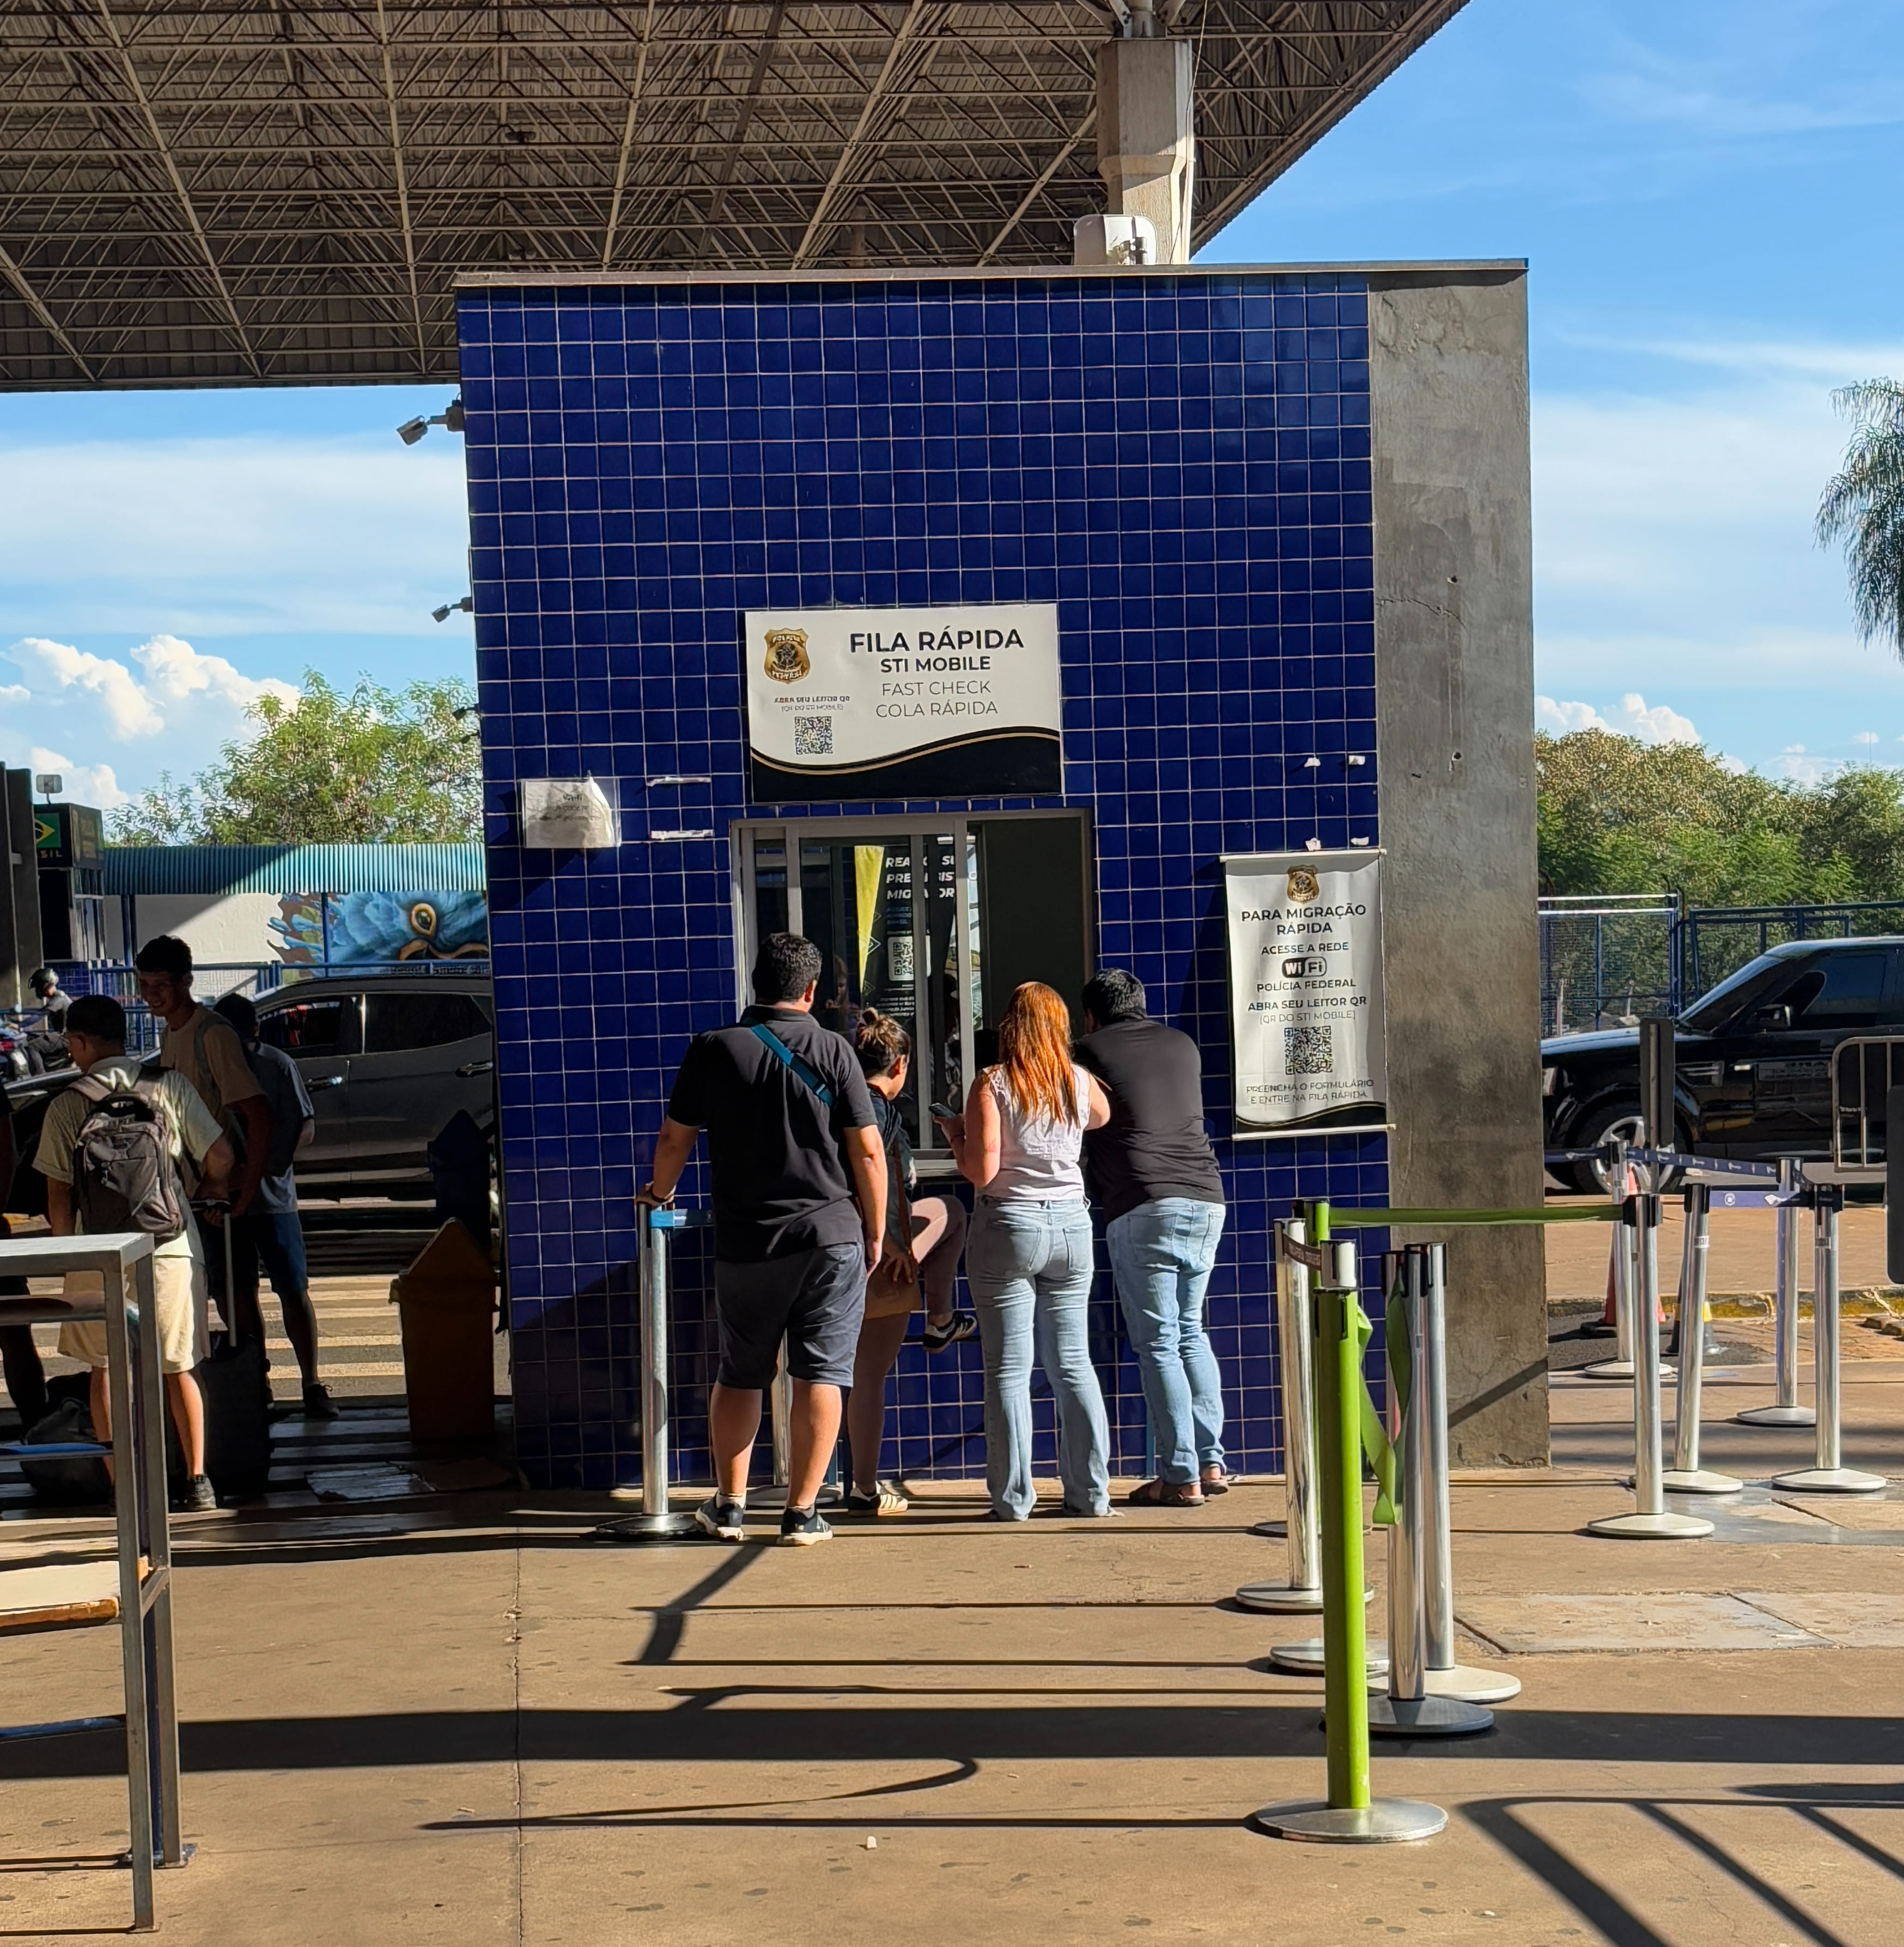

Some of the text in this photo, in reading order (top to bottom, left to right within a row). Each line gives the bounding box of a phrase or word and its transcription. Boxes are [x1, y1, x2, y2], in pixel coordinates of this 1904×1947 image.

[850, 626, 1024, 653] FILA RÁPIDA
[880, 656, 991, 672] STI MOBILE
[883, 680, 991, 696] FAST CHECK
[876, 699, 997, 718] COLA RÁPIDA
[1242, 903, 1366, 921] PARA MIGRAÇÃO
[1277, 922, 1333, 935] RÁPIDA
[1261, 944, 1304, 955] ACESSE
[1319, 942, 1349, 951] REDE
[1257, 979, 1356, 993] POLÍCIA FEDERAL
[1248, 997, 1367, 1011] ABRA SEU LEITOR QR
[1297, 1012, 1311, 1021] STI
[1300, 1082, 1307, 1090] O
[1260, 1095, 1289, 1103] ENTRE
[1293, 1094, 1306, 1102] NA
[1309, 1093, 1329, 1101] FILA
